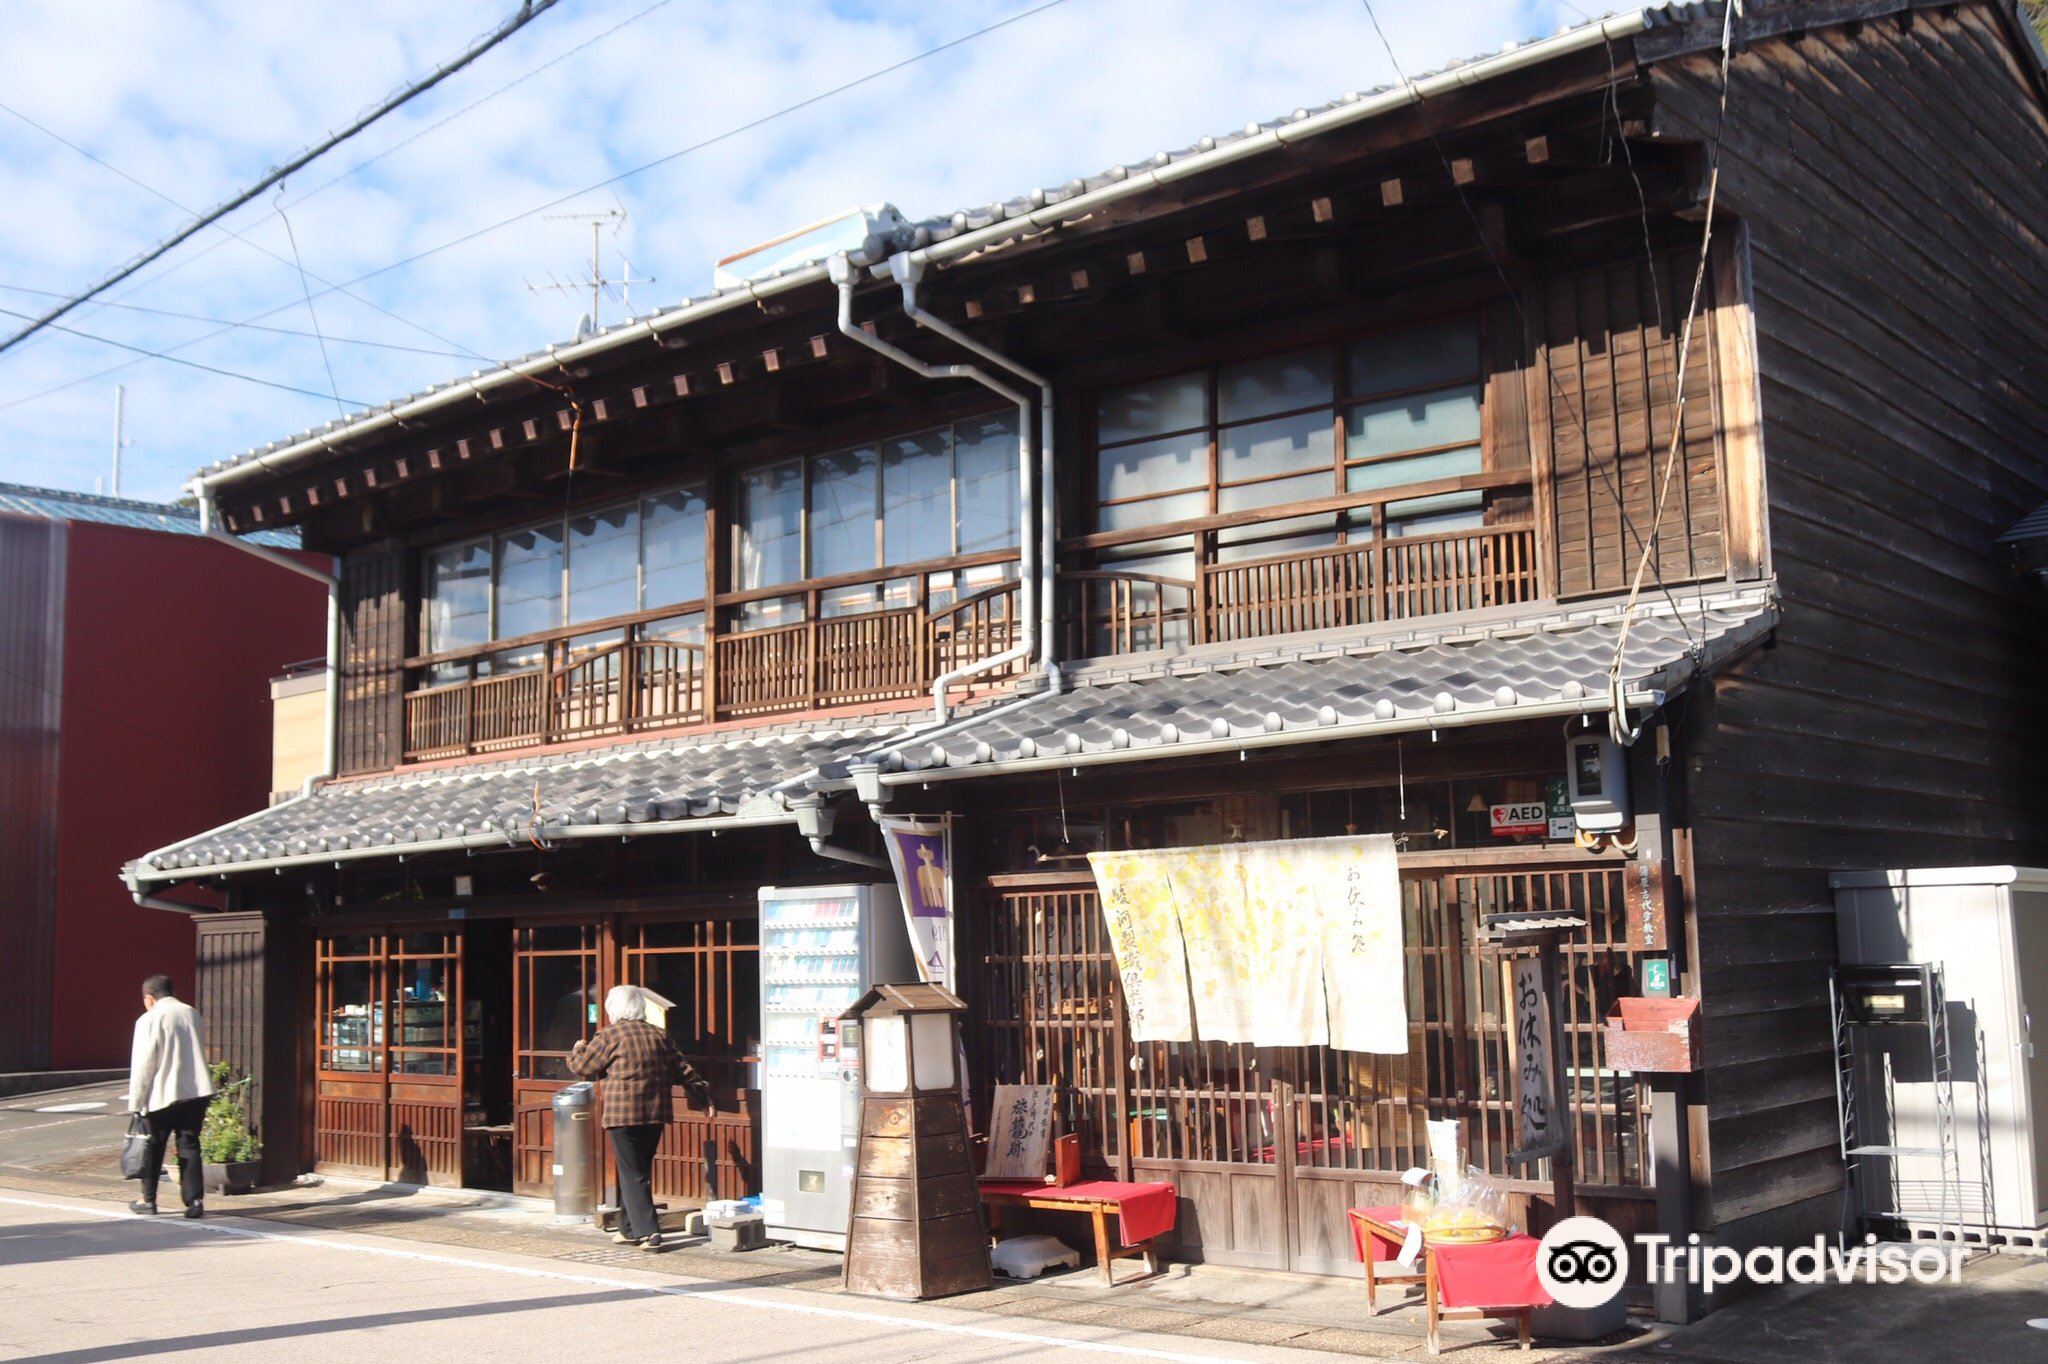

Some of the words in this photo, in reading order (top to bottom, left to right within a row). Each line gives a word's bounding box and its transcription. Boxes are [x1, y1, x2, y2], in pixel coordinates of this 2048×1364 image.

[1508, 806, 1543, 821] AED
[1346, 867, 1367, 954] お休み処
[1516, 971, 1548, 1132] お休み処
